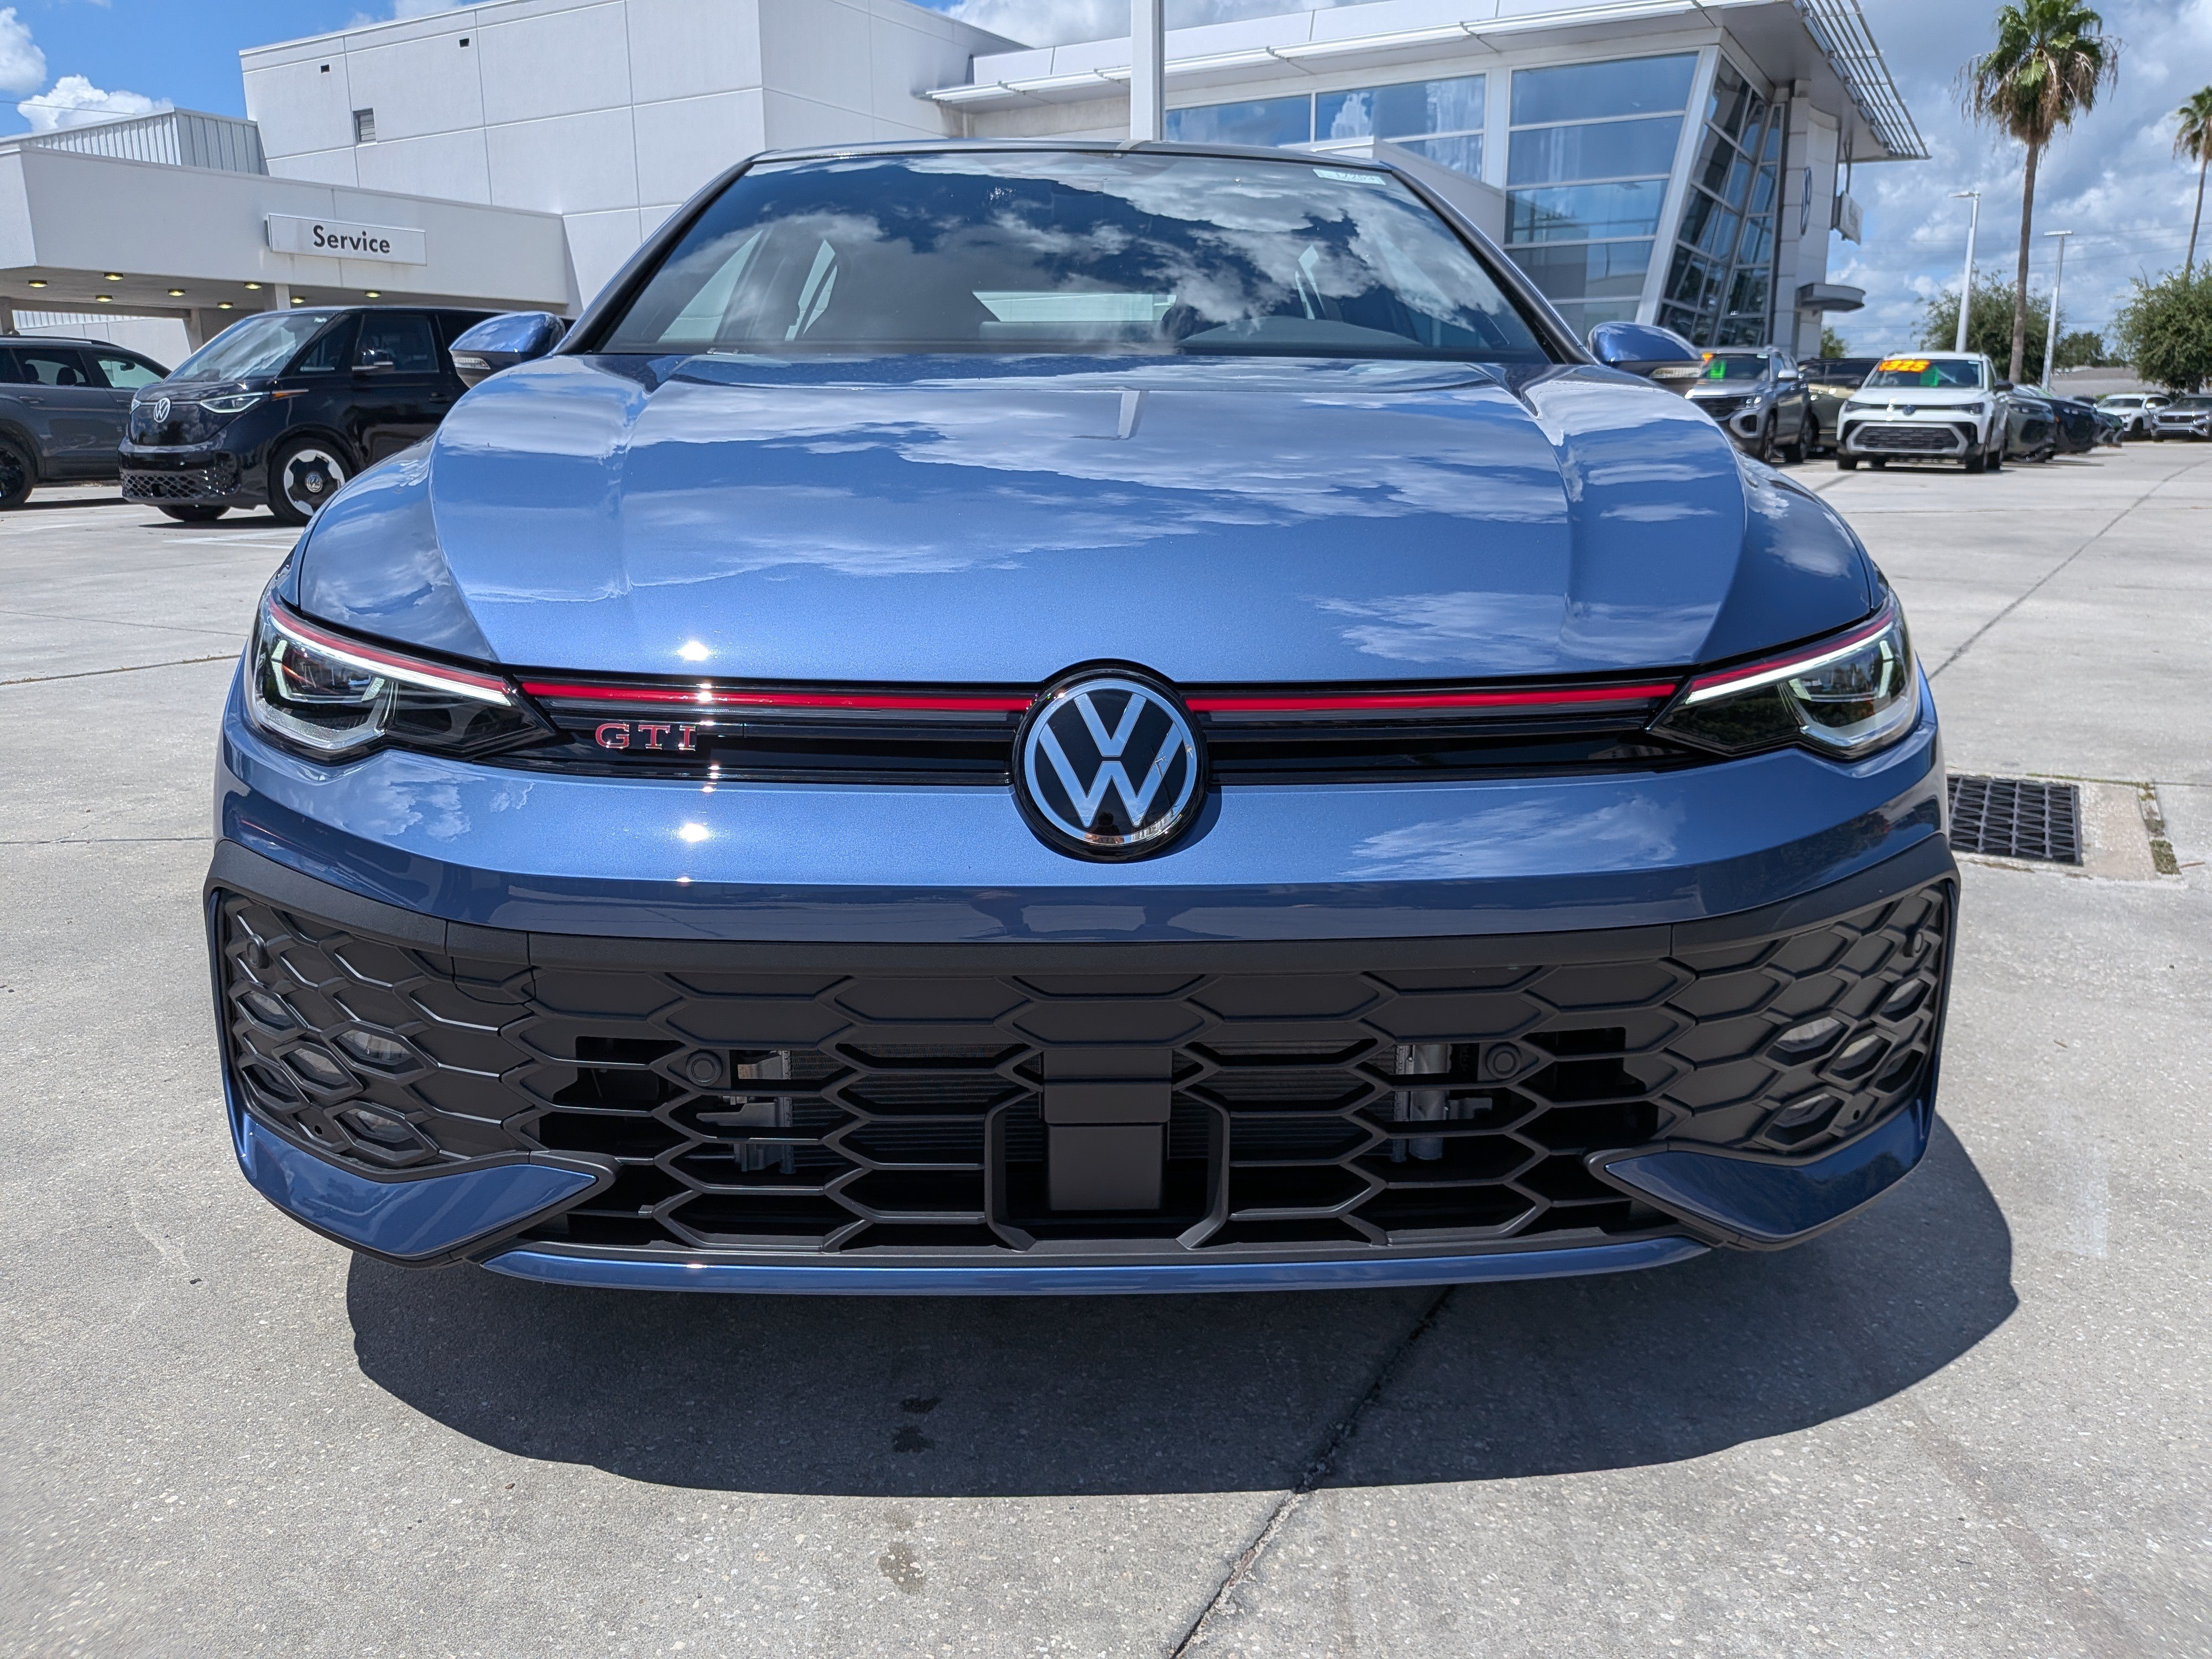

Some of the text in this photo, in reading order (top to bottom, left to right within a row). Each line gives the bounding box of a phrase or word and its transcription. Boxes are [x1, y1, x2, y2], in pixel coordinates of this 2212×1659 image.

[313, 225, 390, 254] Service
[595, 723, 697, 751] GTI
[1037, 690, 1185, 829] VW
